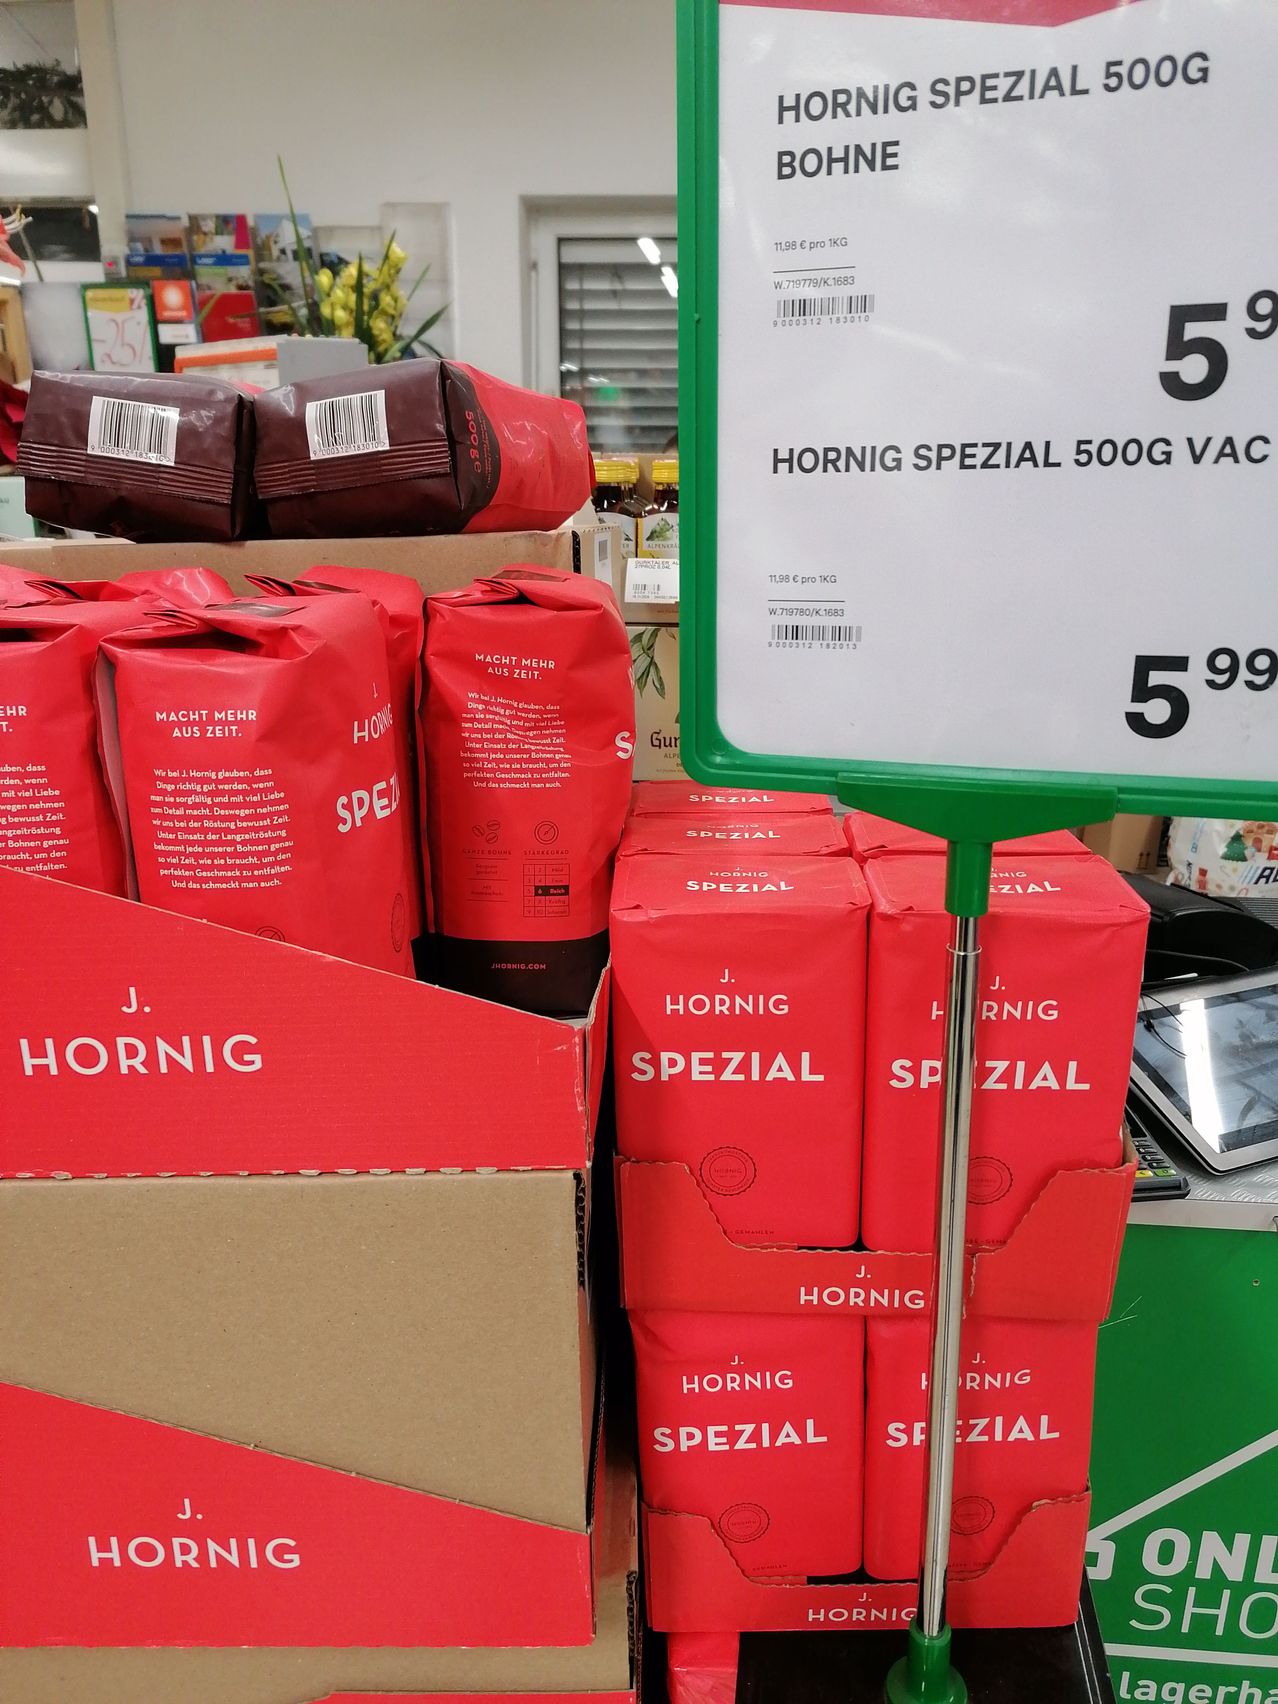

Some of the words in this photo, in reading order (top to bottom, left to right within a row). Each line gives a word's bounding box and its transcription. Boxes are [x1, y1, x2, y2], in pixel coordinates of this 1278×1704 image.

[778, 80, 918, 125] HORNIG
[928, 64, 1090, 110] SPEZIAL
[1102, 51, 1211, 93] 500G
[777, 140, 900, 180] BOHNE
[774, 240, 797, 252] 11,98
[800, 240, 806, 249] €
[809, 240, 825, 251] pro
[829, 237, 848, 247] 1KG
[773, 276, 855, 290] W.719779/K.1683
[1159, 302, 1228, 401] 5
[772, 444, 902, 474] HORNIG
[912, 440, 1062, 471] SPEZIAL
[1073, 437, 1173, 467] 500G
[1186, 435, 1271, 465] VAC
[769, 575, 790, 584] 11,98
[793, 575, 799, 583] €
[801, 576, 816, 584] pro
[819, 575, 837, 583] 1KG
[768, 608, 845, 617] W.719780/K.1683
[475, 653, 518, 665] MACHT
[521, 658, 555, 669] MEHR
[487, 667, 509, 676] AUS
[513, 670, 542, 680] ZEIT.
[1125, 655, 1190, 739] 5
[1205, 647, 1278, 691] 99
[155, 710, 208, 722] MACHT
[214, 710, 257, 721] MEHR
[172, 726, 201, 737] AUS
[206, 726, 242, 737] ZEIT.
[154, 769, 166, 777] Wir
[168, 769, 180, 777] bei
[190, 770, 216, 779] Hornig
[218, 769, 252, 779] glauben,
[254, 768, 272, 776] dass
[156, 781, 175, 791] Dinge
[177, 782, 201, 791] richtig
[203, 782, 216, 791] gut
[218, 781, 250, 791] werden,
[252, 781, 274, 789] wenn
[35, 789, 60, 797] Liebe
[176, 795, 212, 804] sorgfältig
[245, 793, 260, 801] viel
[262, 792, 285, 801] Liebe
[689, 794, 775, 803] SPEZIAL
[29, 801, 65, 809] nehmen
[164, 807, 184, 815] Detail
[214, 807, 255, 816] Deswegen
[257, 804, 289, 813] nehmen
[8, 814, 43, 822] bewusst
[152, 818, 162, 826] wir
[175, 818, 187, 827] bei
[189, 819, 201, 828] der
[204, 820, 235, 829] Röstung
[237, 818, 271, 827] bewusst
[273, 816, 291, 824] Zeit.
[157, 831, 176, 839] Unter
[178, 832, 205, 840] Einsatz
[207, 832, 220, 840] der
[222, 829, 287, 841] Langzeitröstung
[686, 831, 781, 839] SPEZIAL
[8, 839, 45, 847] Bohnen
[154, 842, 185, 851] bekommt
[186, 844, 203, 853] jede
[237, 844, 268, 852] Bohnen
[270, 840, 294, 851] genau
[180, 856, 197, 865] Zeit,
[199, 857, 212, 865] wie
[214, 857, 225, 865] sie
[226, 856, 260, 865] braucht,
[277, 852, 291, 861] den
[160, 868, 194, 877] perfekten
[196, 868, 240, 877] Geschmack
[254, 864, 292, 876] entfalten.
[171, 880, 186, 888] Und
[188, 880, 200, 888] das
[202, 880, 239, 889] schmeckt
[260, 879, 282, 887] auch.
[686, 881, 794, 892] SPEZIAL
[720, 968, 735, 983] J.
[990, 976, 1006, 990] J.
[121, 986, 152, 1014] J.
[666, 994, 789, 1015] HORNIG
[931, 1000, 1059, 1021] HRNIG
[18, 1034, 263, 1076] HORNIG
[631, 1051, 825, 1082] SPEZIAL
[889, 1058, 1091, 1091] SPZIAL
[856, 1265, 872, 1278] J.
[800, 1287, 925, 1309] HORNIG
[730, 1355, 744, 1365] J.
[972, 1352, 986, 1364] J.
[682, 1370, 793, 1394] HORNIG
[653, 1418, 828, 1452] SPEZIAL
[177, 1498, 204, 1520] J.
[87, 1536, 300, 1569] HORNIG
[858, 1592, 872, 1602] J.
[808, 1607, 919, 1622] HORNIG
